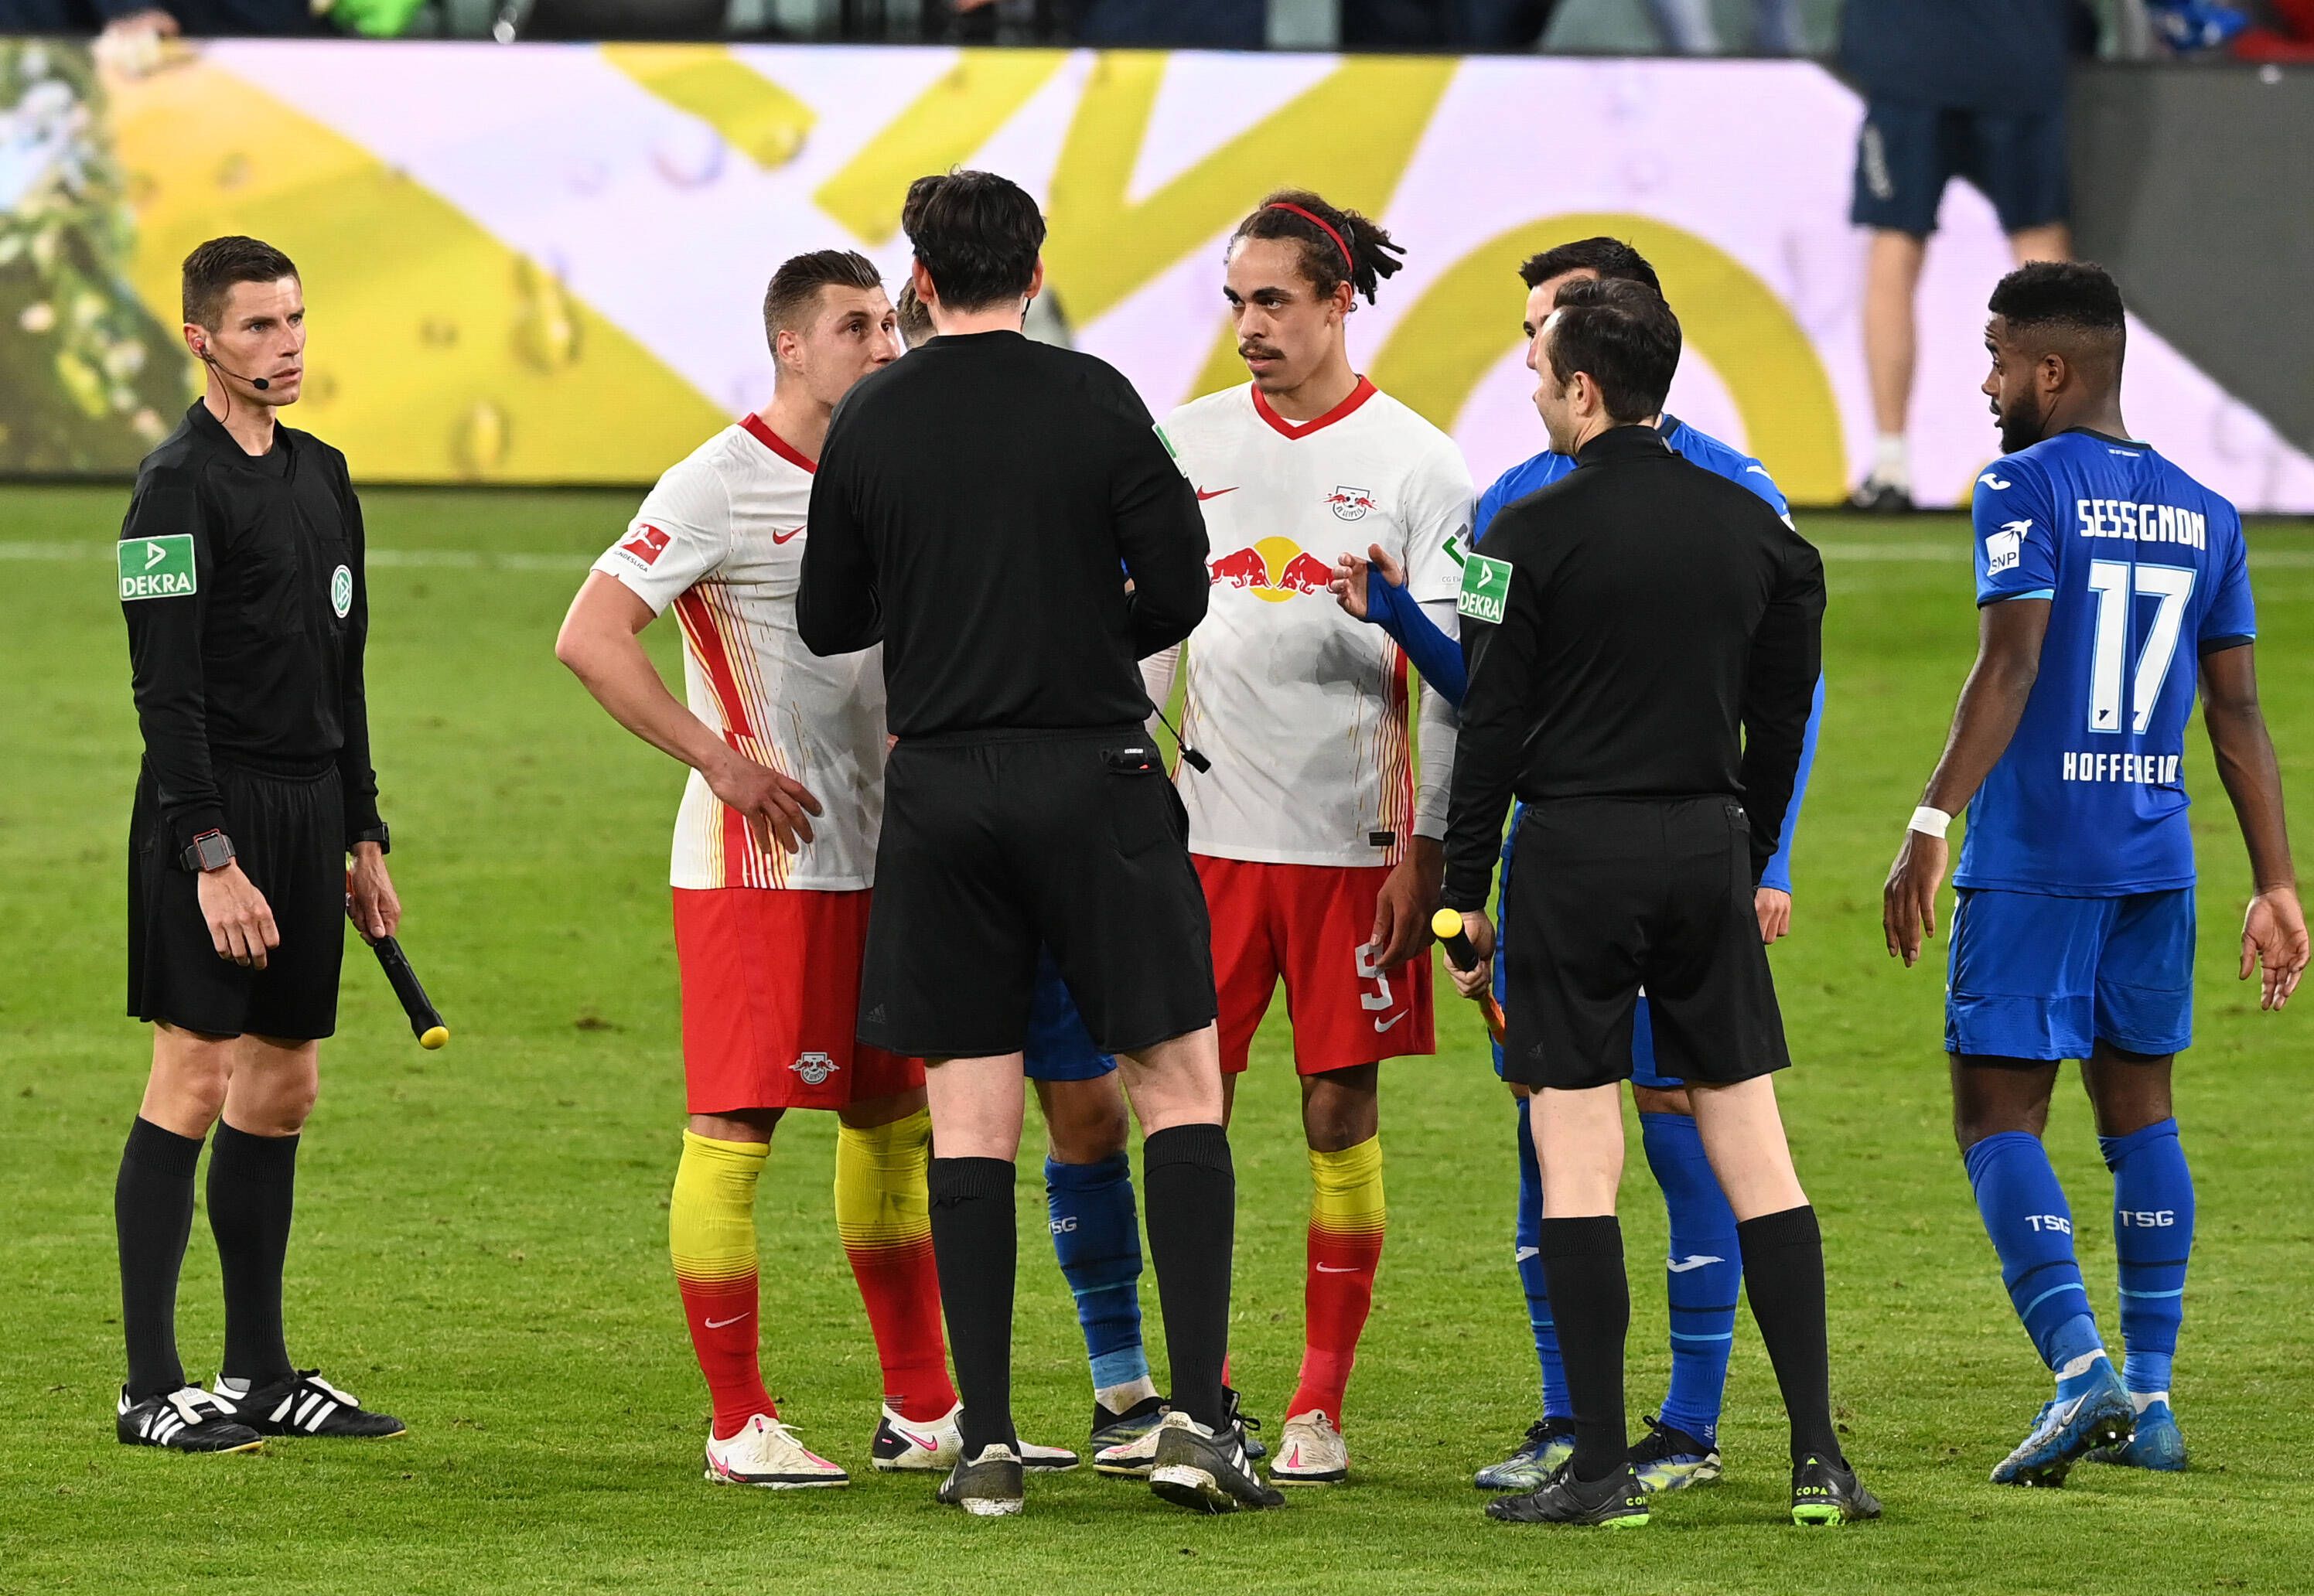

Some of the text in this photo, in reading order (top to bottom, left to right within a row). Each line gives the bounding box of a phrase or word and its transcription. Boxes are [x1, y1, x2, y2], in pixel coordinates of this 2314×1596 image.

[2077, 499, 2206, 551] SESSGNON
[1991, 551, 2017, 572] SNP
[121, 571, 192, 597] DEKRA
[1459, 590, 1500, 619] DEKRA
[2088, 558, 2197, 735] 17
[2025, 1214, 2071, 1236] TSG
[2118, 1210, 2175, 1228] TSG
[1796, 1485, 1828, 1496] COPA
